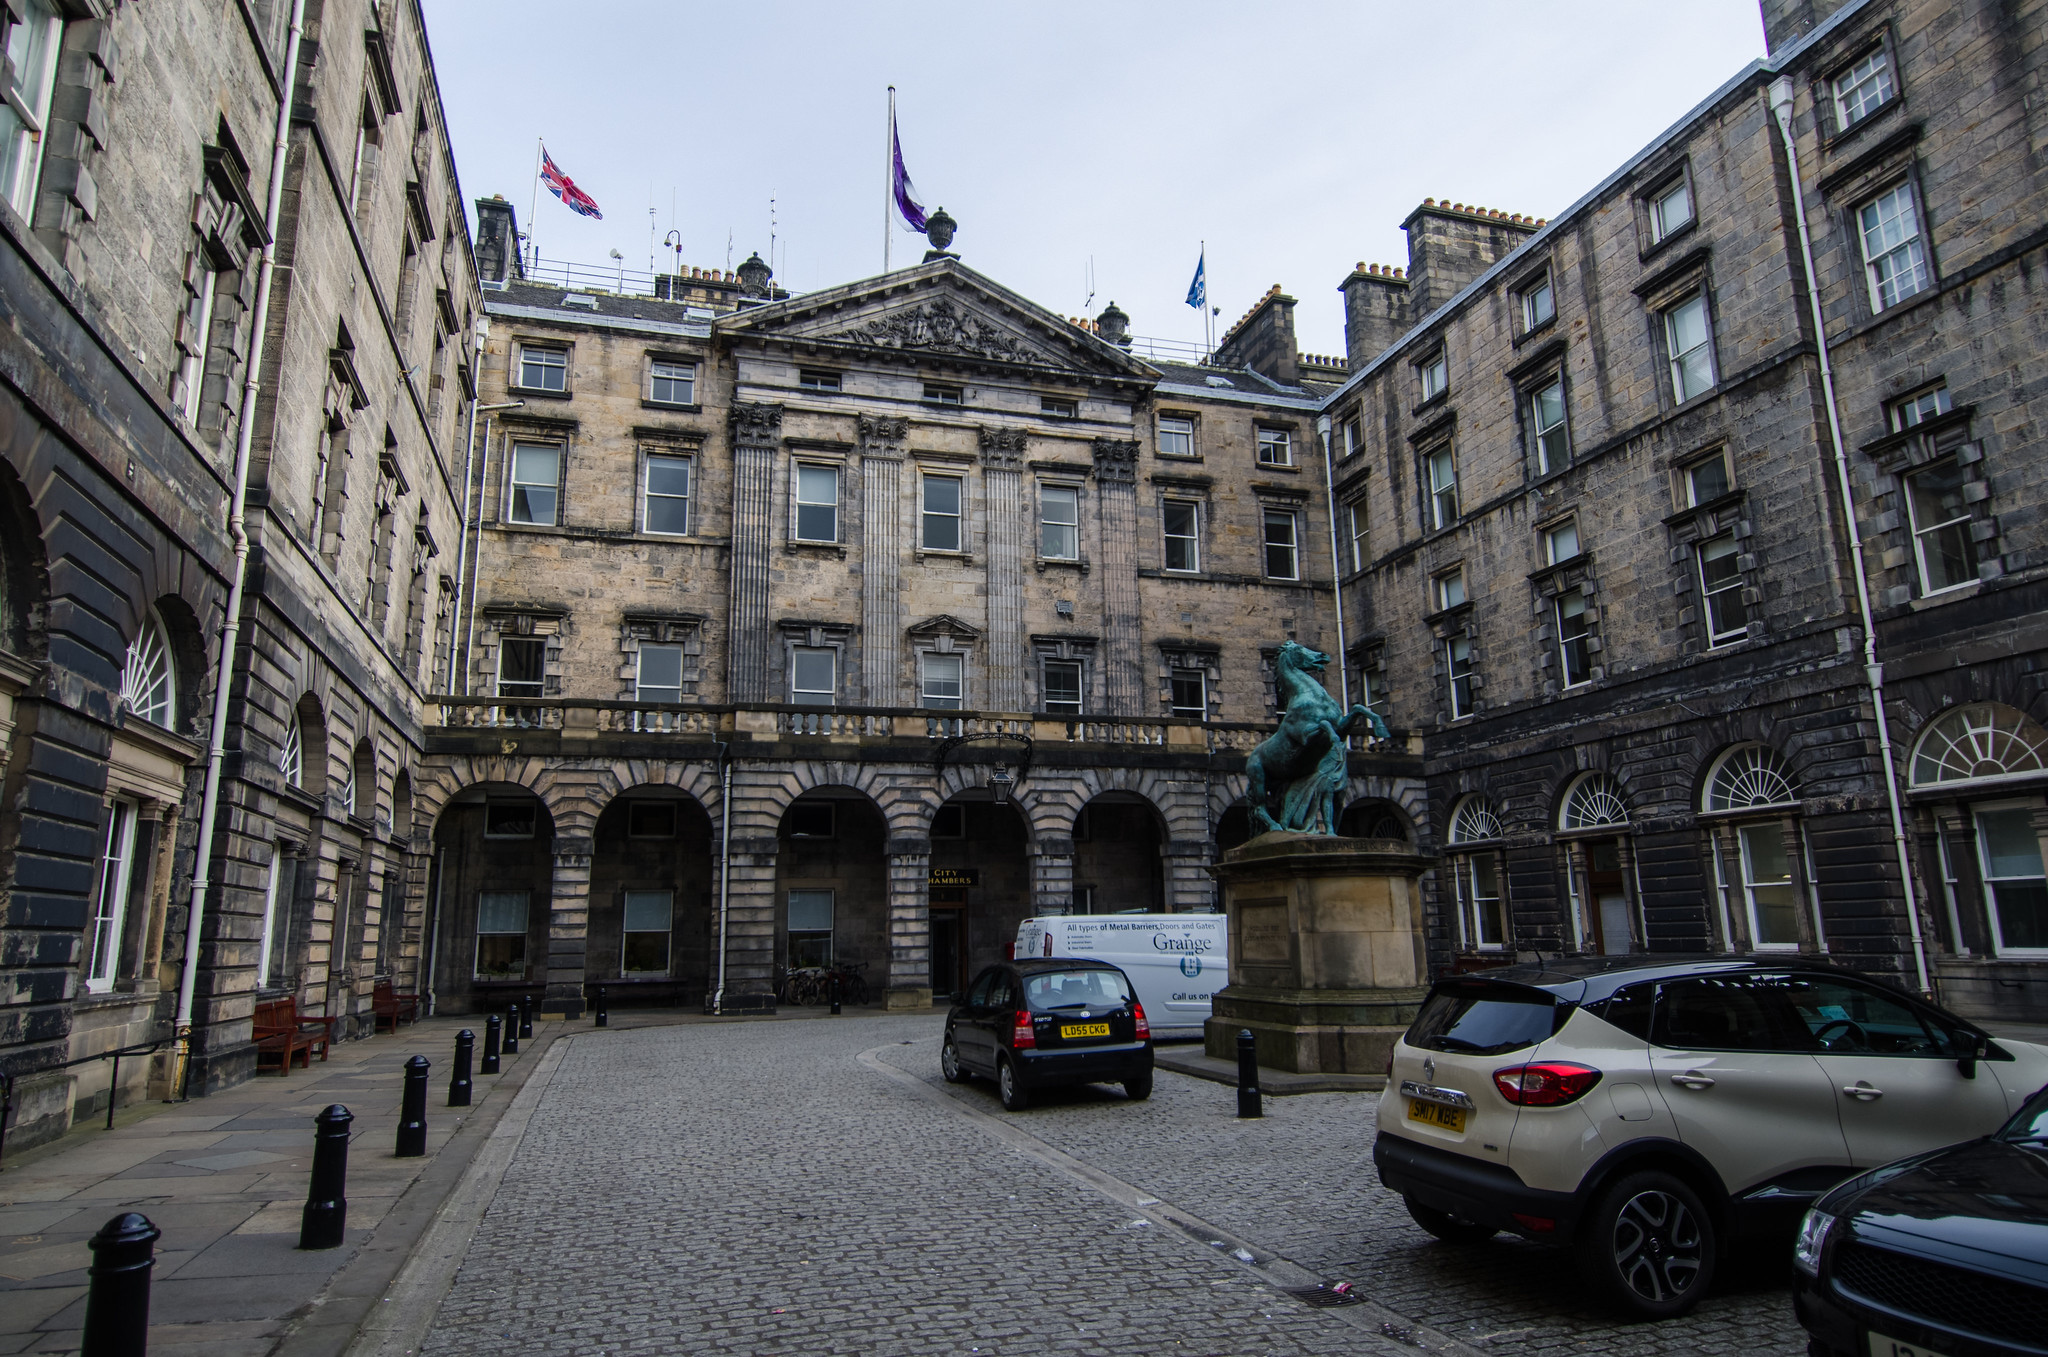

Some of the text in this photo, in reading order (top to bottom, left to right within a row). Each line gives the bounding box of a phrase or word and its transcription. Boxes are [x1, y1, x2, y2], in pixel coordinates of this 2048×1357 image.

[1079, 925, 1098, 933] types
[1100, 923, 1107, 931] of
[1109, 923, 1130, 931] Metal
[1182, 922, 1194, 930] and
[1196, 922, 1215, 930] Gates
[1153, 932, 1212, 955] Grange
[1172, 992, 1186, 1000] Call
[1064, 1025, 1106, 1036] LD55 CKG
